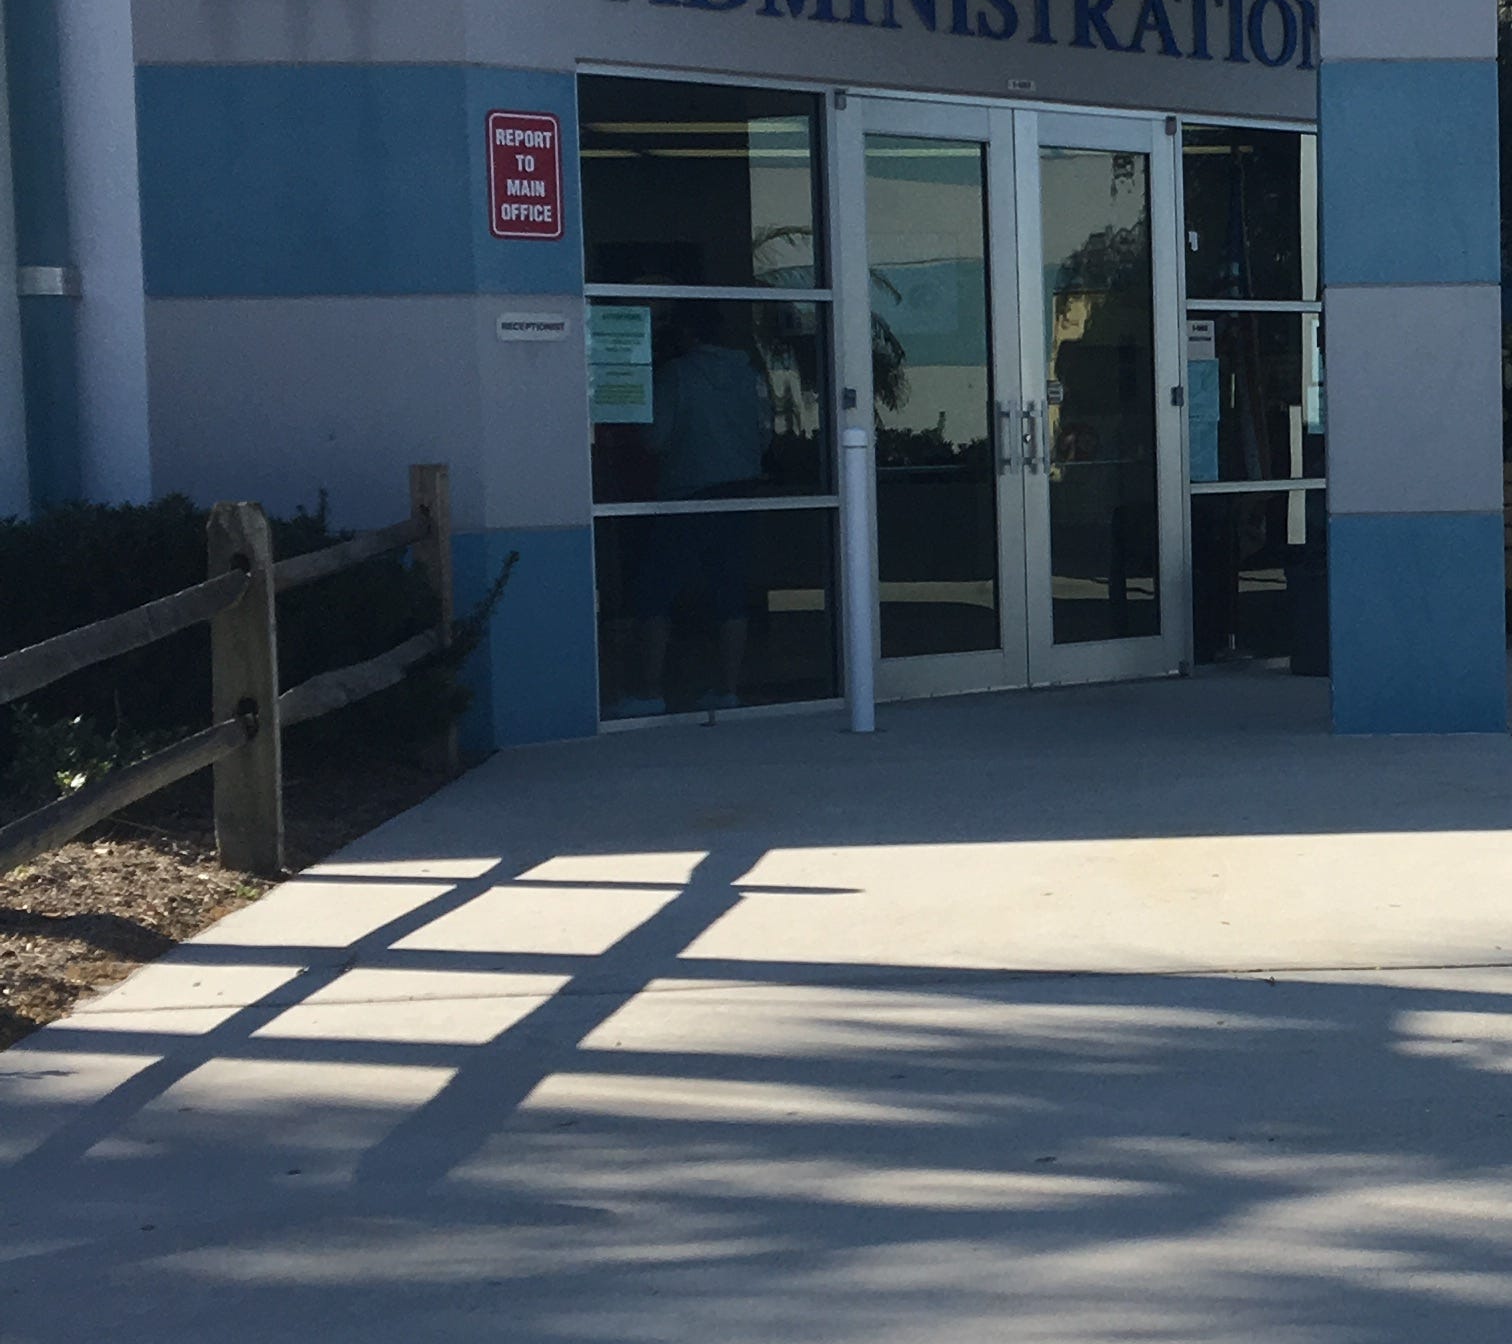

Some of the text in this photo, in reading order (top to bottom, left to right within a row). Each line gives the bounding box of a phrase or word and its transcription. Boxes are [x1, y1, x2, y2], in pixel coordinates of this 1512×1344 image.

[495, 128, 552, 149] REPORT
[515, 155, 535, 173] TO
[506, 179, 546, 198] MAIN
[501, 203, 552, 223] OFFICE
